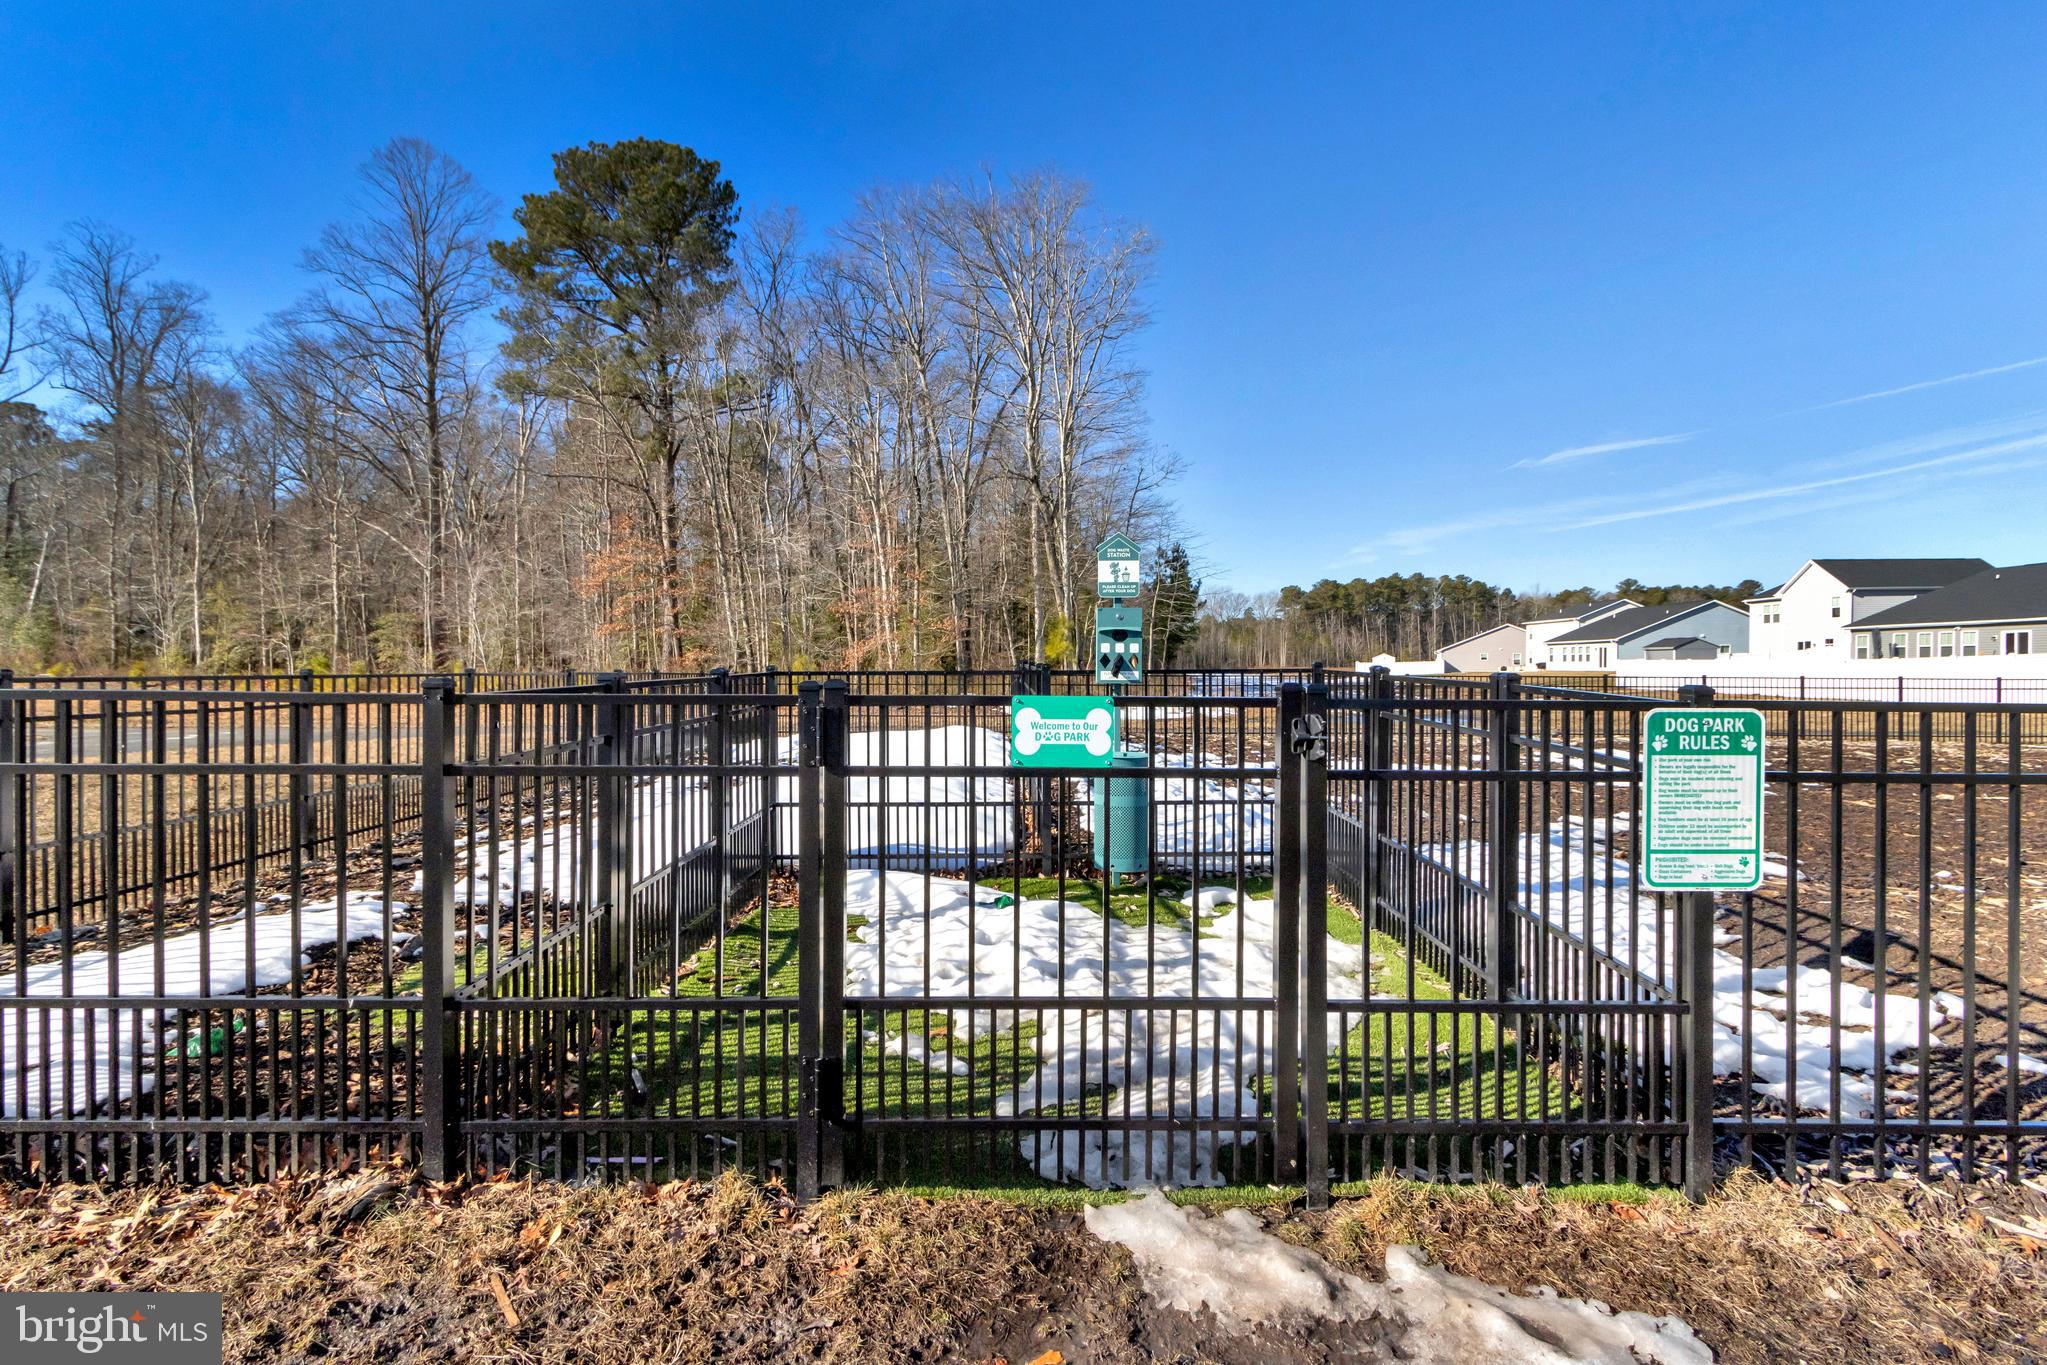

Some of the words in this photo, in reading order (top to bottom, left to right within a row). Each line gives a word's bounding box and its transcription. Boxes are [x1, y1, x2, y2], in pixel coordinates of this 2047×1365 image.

[1030, 721, 1070, 730] Welcome
[1072, 722, 1080, 730] to
[1083, 722, 1098, 730] Our
[1665, 718, 1698, 733] DOG
[1703, 718, 1745, 732] PARK
[1064, 733, 1090, 741] PARK
[1679, 735, 1730, 750] RULES
